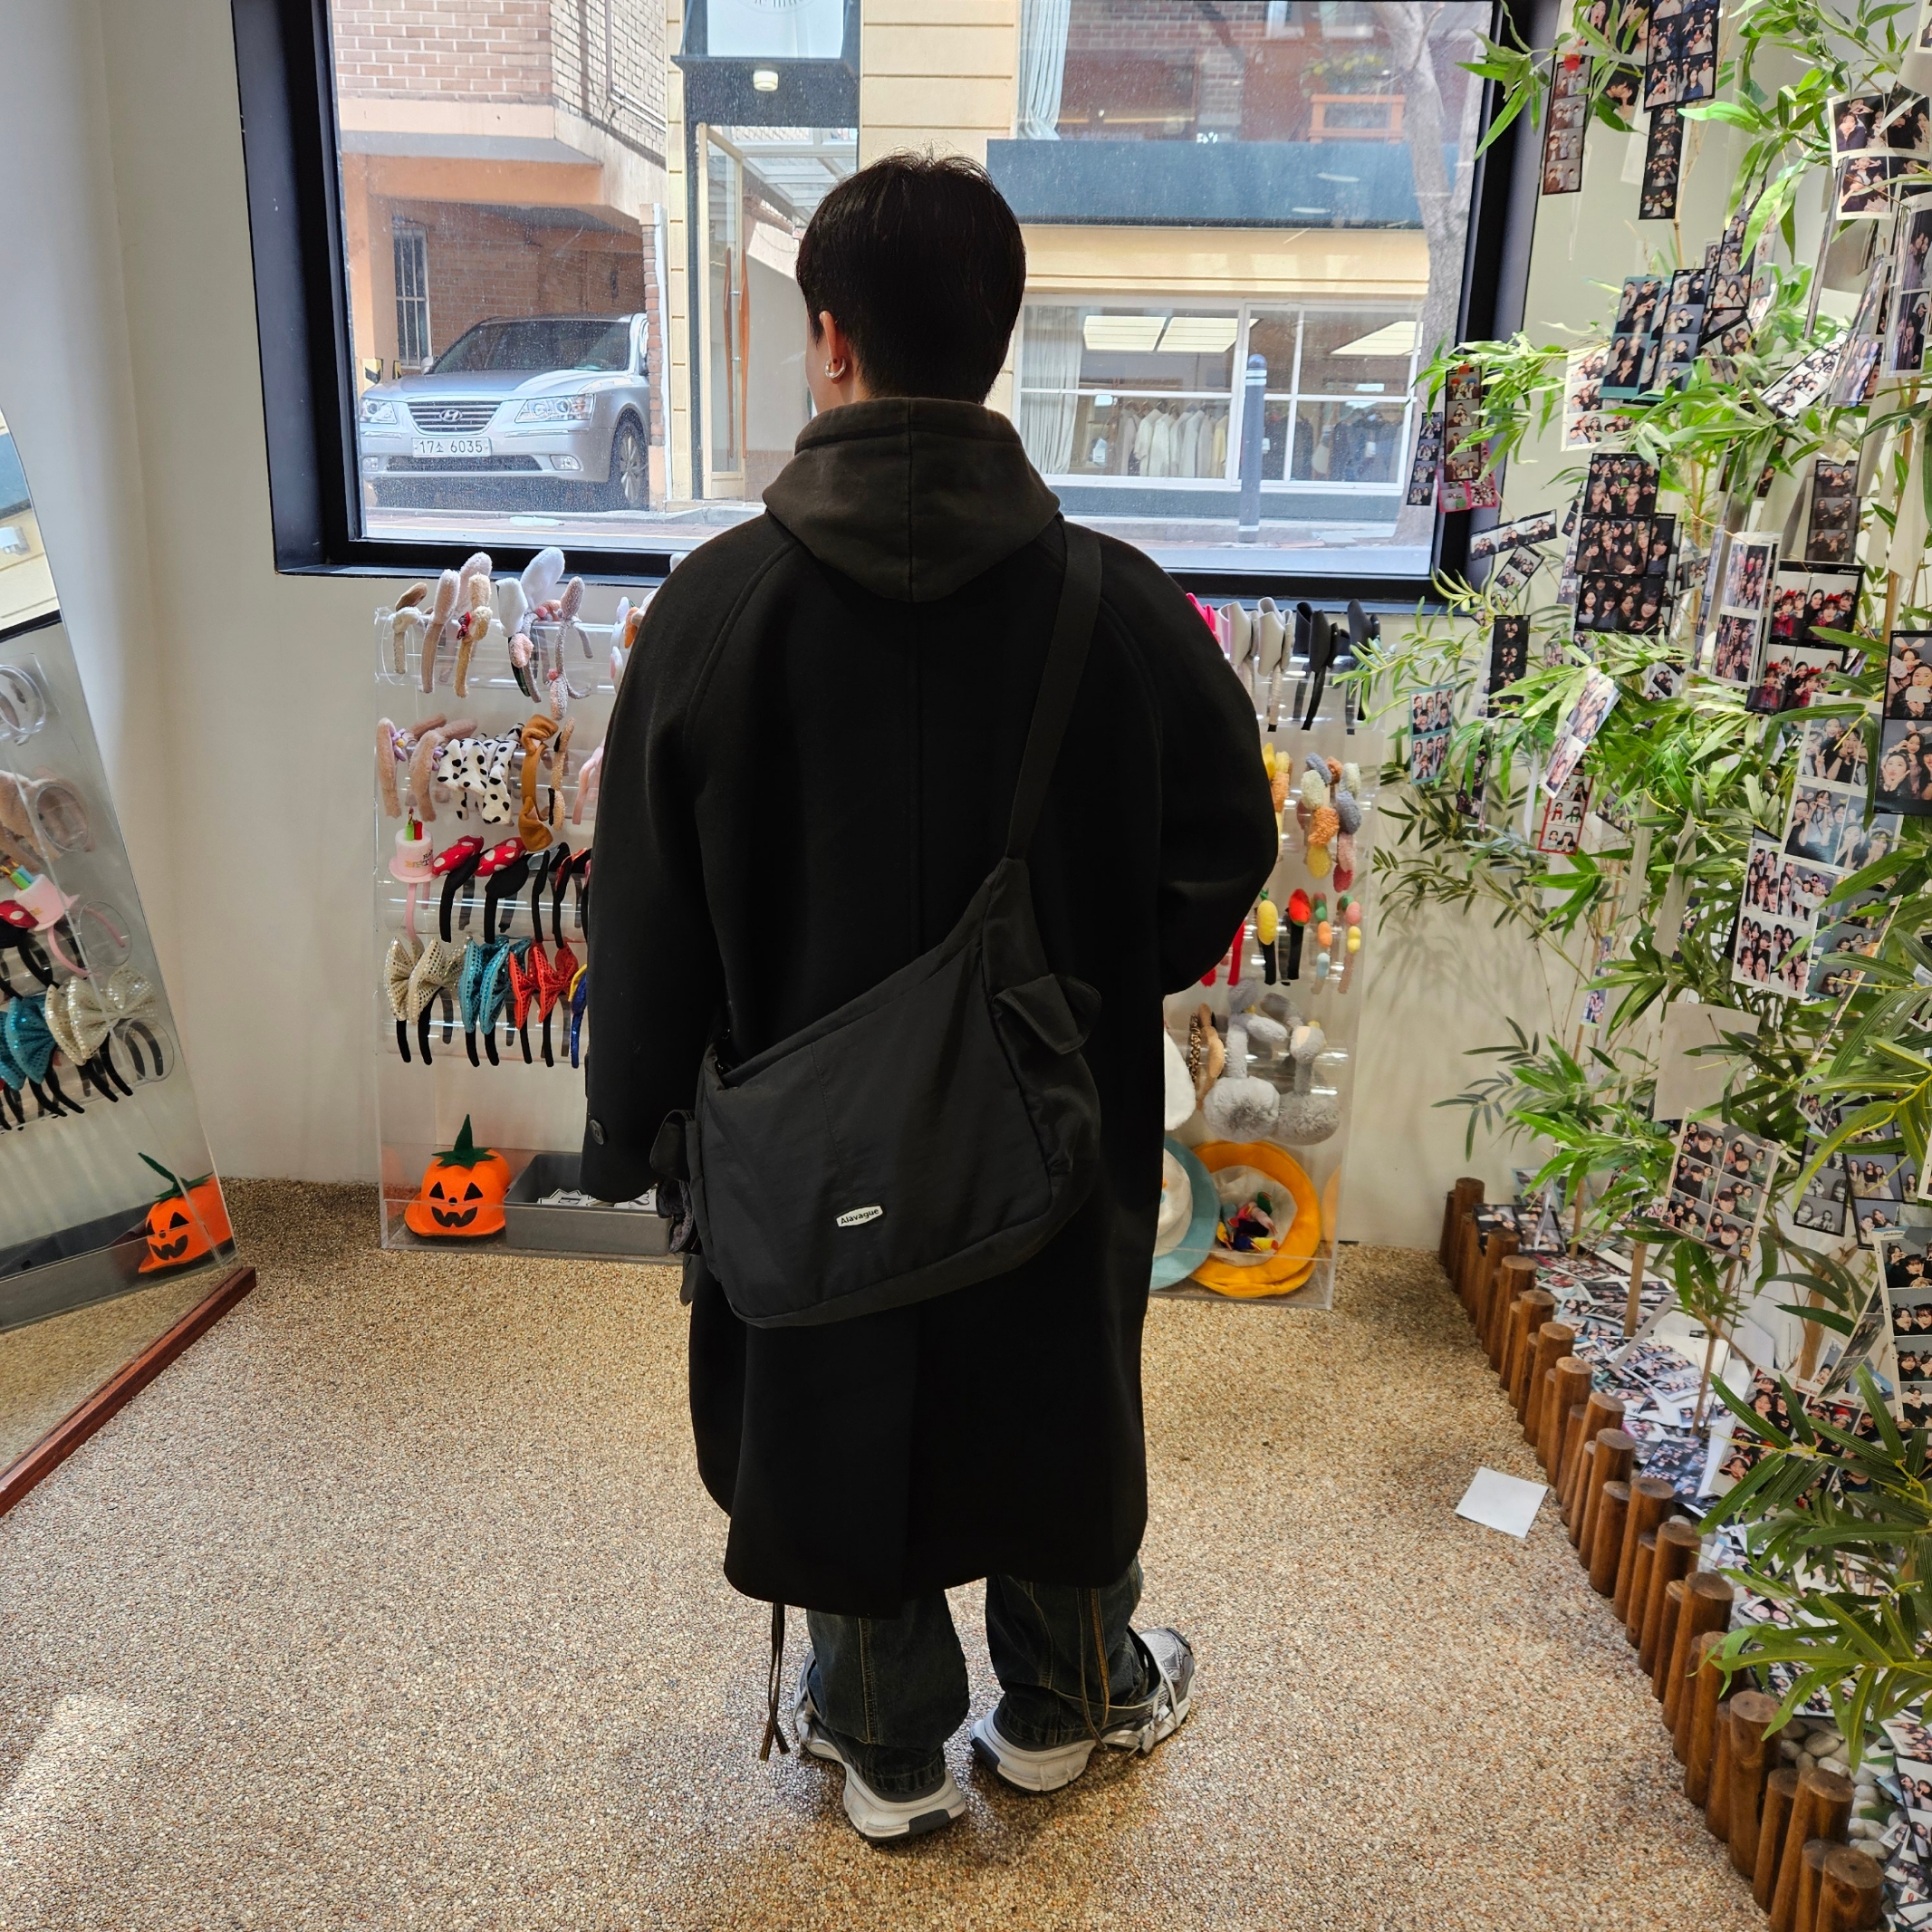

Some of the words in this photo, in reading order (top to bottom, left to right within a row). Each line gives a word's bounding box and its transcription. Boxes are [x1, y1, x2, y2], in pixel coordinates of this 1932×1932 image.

[419, 440, 444, 454] 17소
[450, 439, 483, 453] 6035
[841, 1208, 879, 1225] Alavague
